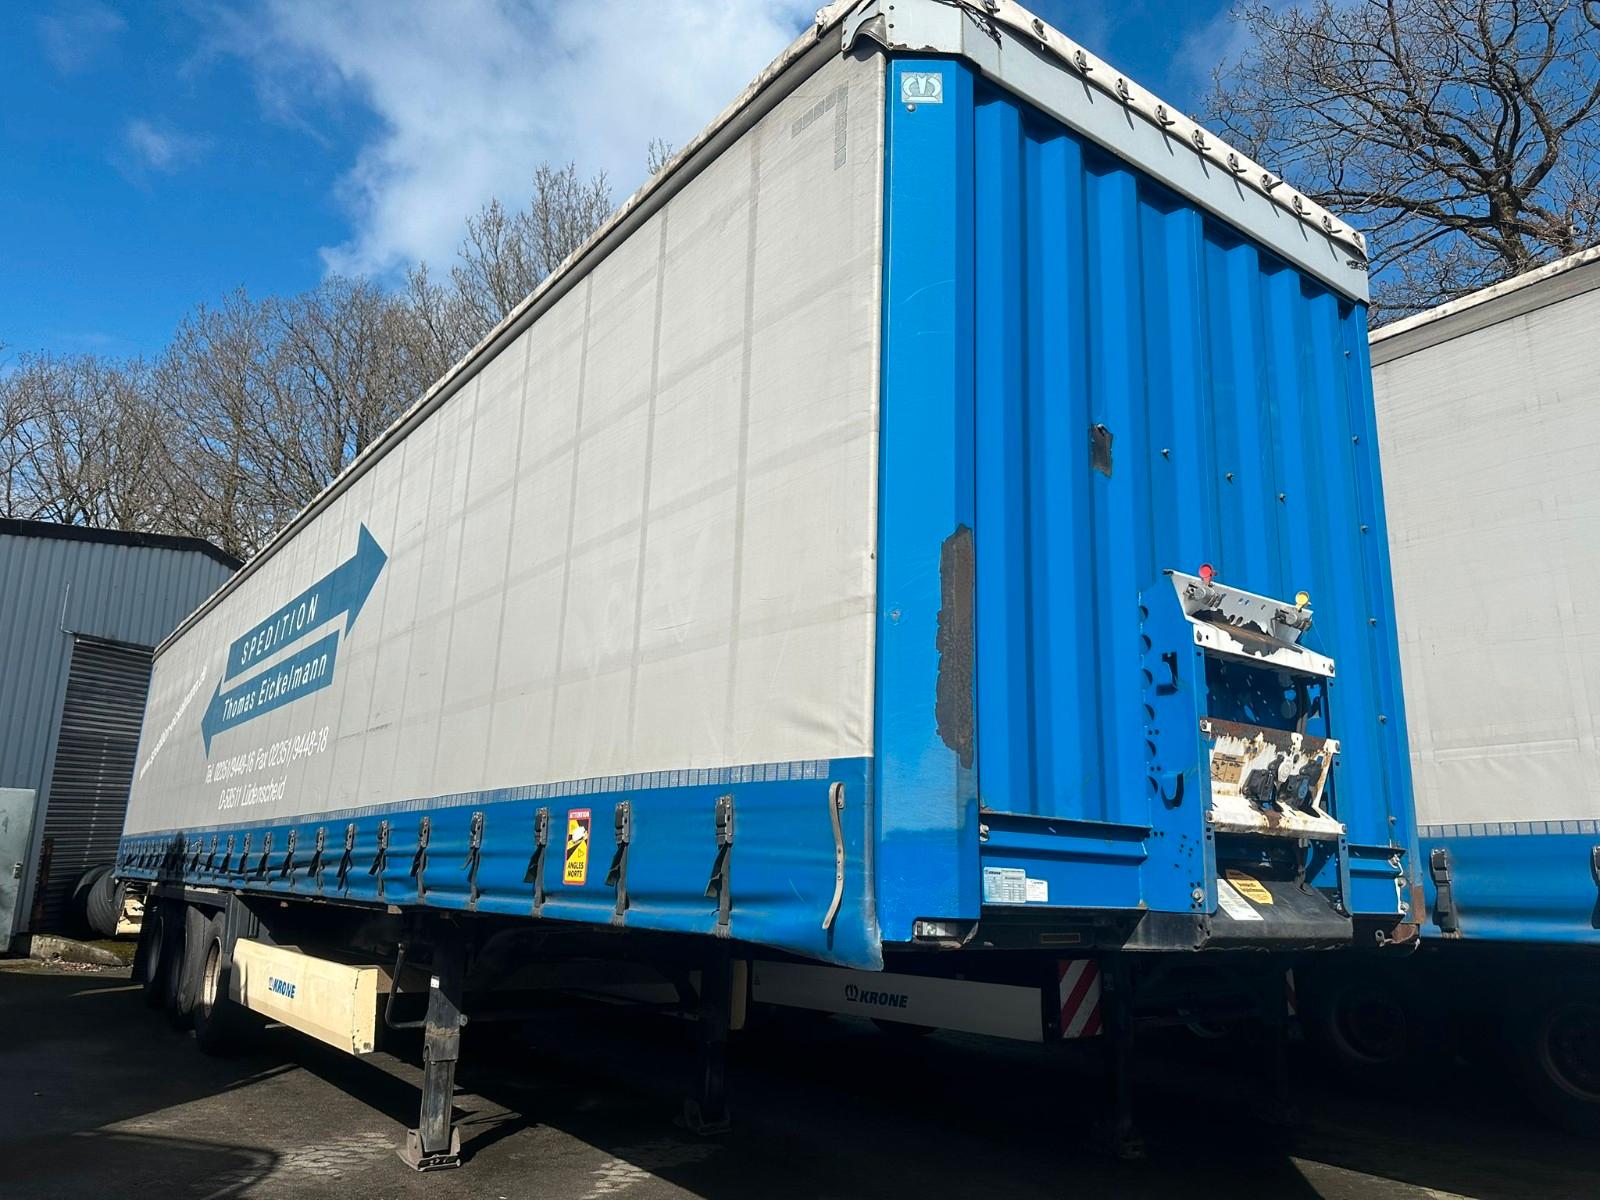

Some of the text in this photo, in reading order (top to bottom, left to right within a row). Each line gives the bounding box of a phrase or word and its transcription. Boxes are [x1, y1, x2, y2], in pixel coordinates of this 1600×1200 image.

[241, 593, 319, 665] SPEDITION
[222, 653, 328, 721] Thomas Eickelmann
[254, 747, 268, 771] Fax
[267, 725, 330, 768] 02351/9448-18
[241, 774, 288, 806] Lüdenscheid
[567, 861, 584, 870] ANGLES
[567, 870, 583, 878] MORTS
[272, 977, 296, 999] KRONE
[859, 990, 909, 1009] KRONE
